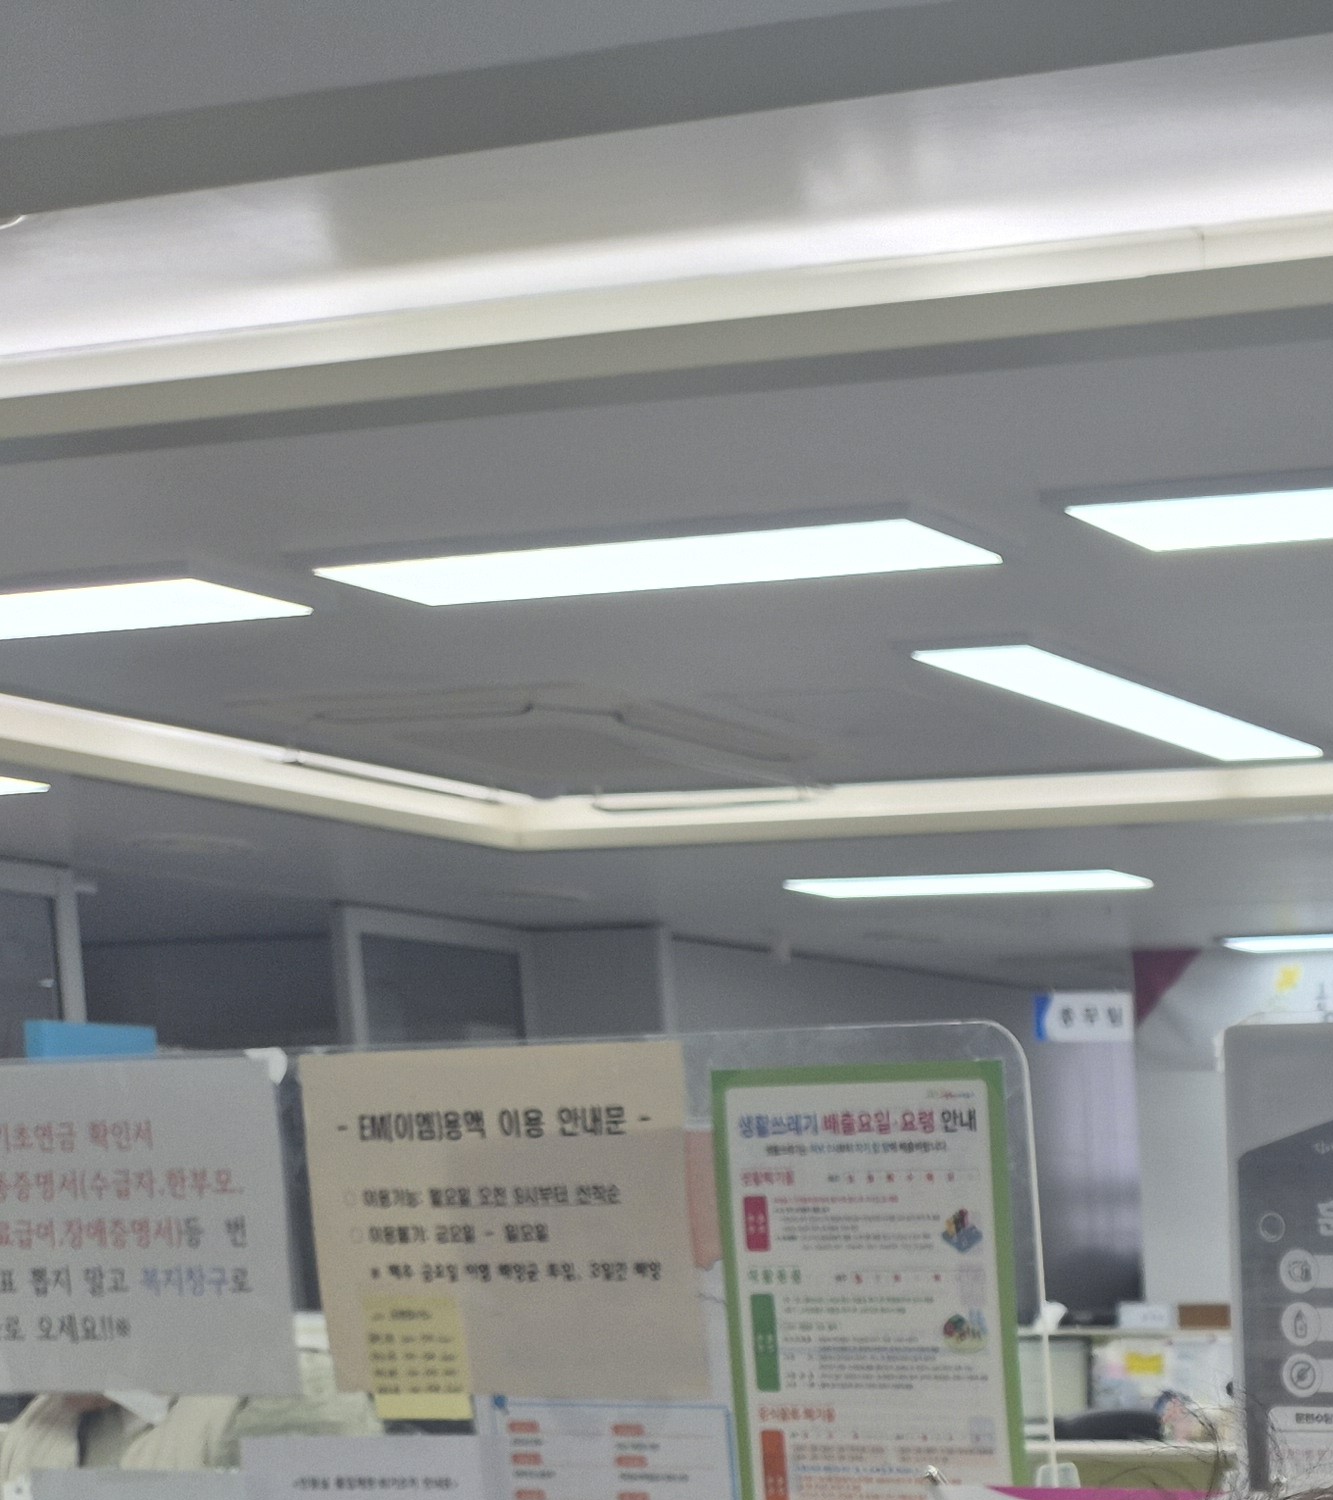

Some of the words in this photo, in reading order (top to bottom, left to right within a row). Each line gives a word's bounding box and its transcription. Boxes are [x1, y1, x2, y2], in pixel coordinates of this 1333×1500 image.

[89, 1120, 154, 1152] 확인서
[499, 1108, 545, 1139] 이용
[557, 1105, 627, 1137] 안내문
[738, 1113, 819, 1139] 생활쓰레기
[940, 1108, 977, 1133] 안내
